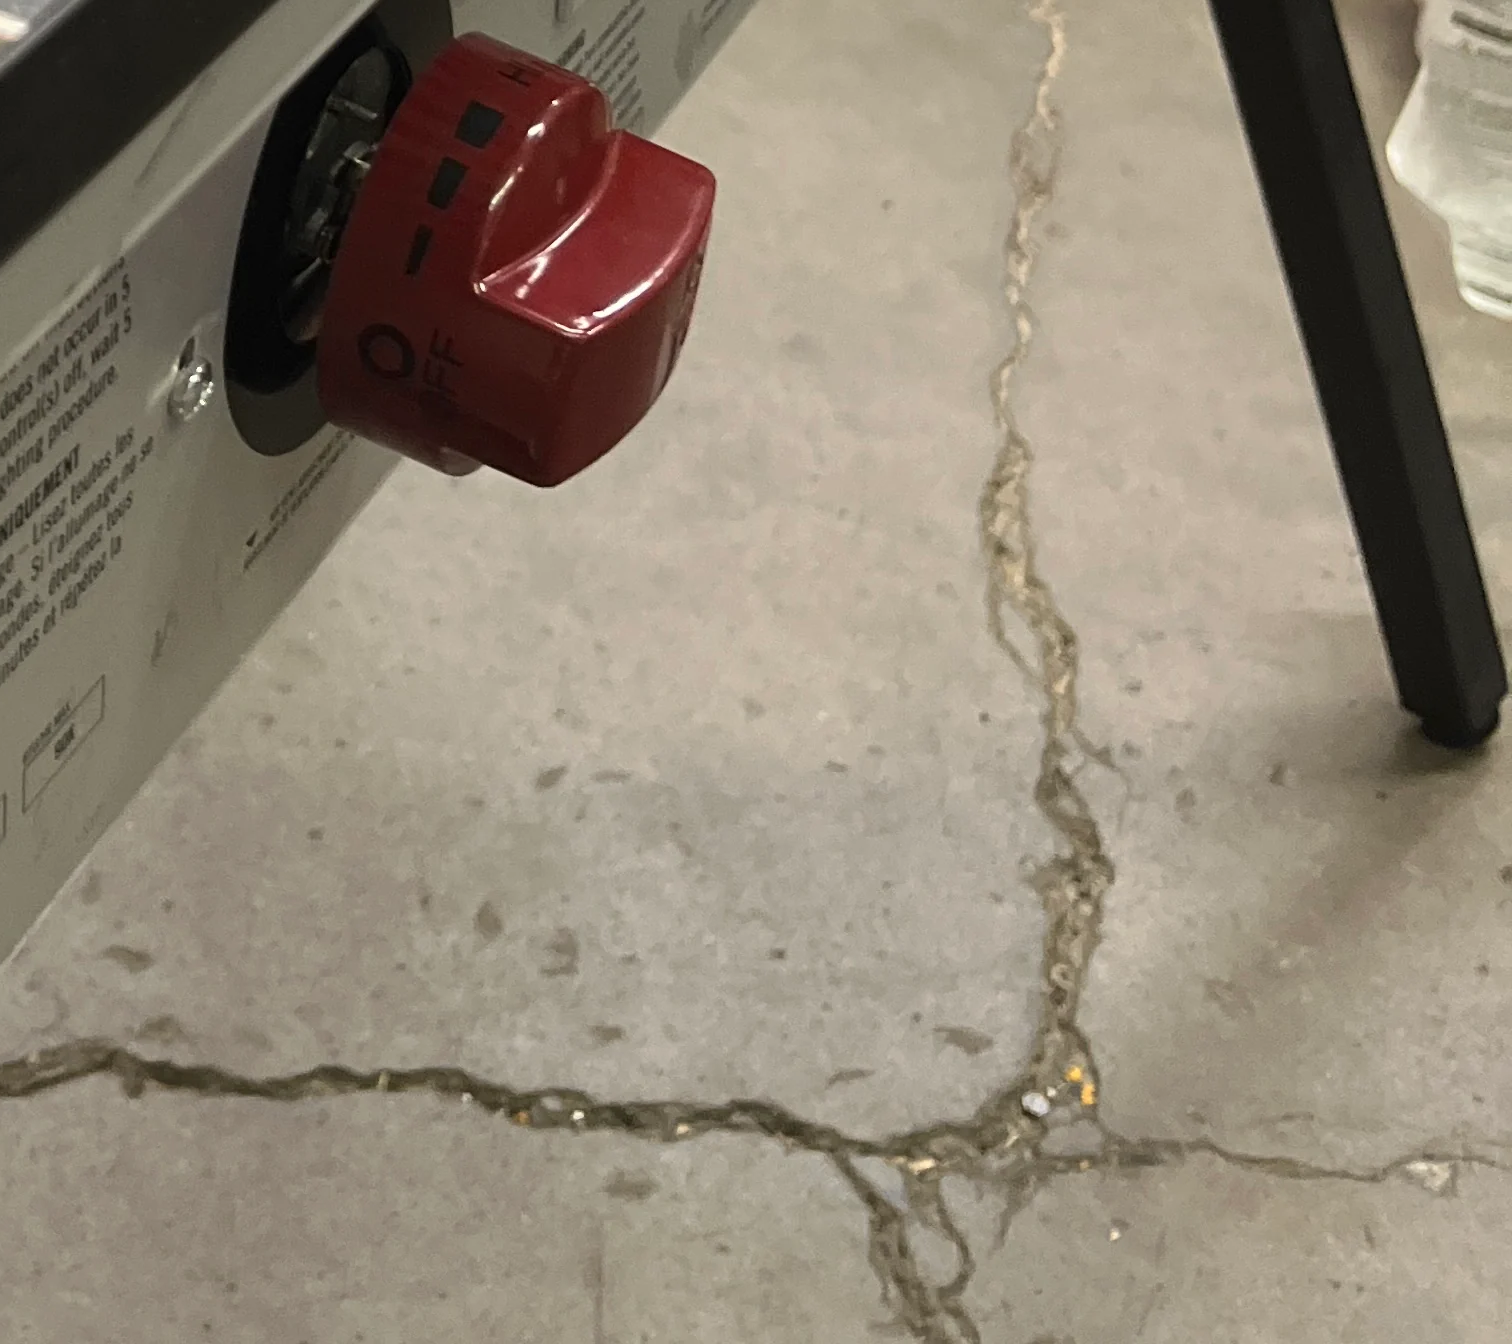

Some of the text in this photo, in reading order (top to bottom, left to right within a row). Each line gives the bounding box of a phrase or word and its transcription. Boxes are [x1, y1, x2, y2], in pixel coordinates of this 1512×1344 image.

[0, 373, 32, 422] does
[37, 341, 59, 385] not
[63, 304, 101, 360] occur
[104, 288, 117, 320] in
[121, 269, 130, 303] 5
[90, 319, 119, 367] wait
[123, 305, 131, 336] 5
[416, 328, 465, 411] OFF
[31, 549, 43, 583] Si
[48, 473, 118, 563] l'allumage
[140, 433, 152, 464] se
[32, 495, 66, 547] Lisez
[70, 446, 111, 507] toutes
[115, 422, 134, 459] les
[106, 487, 133, 534] tous
[42, 604, 56, 637] et
[109, 530, 122, 562] la
